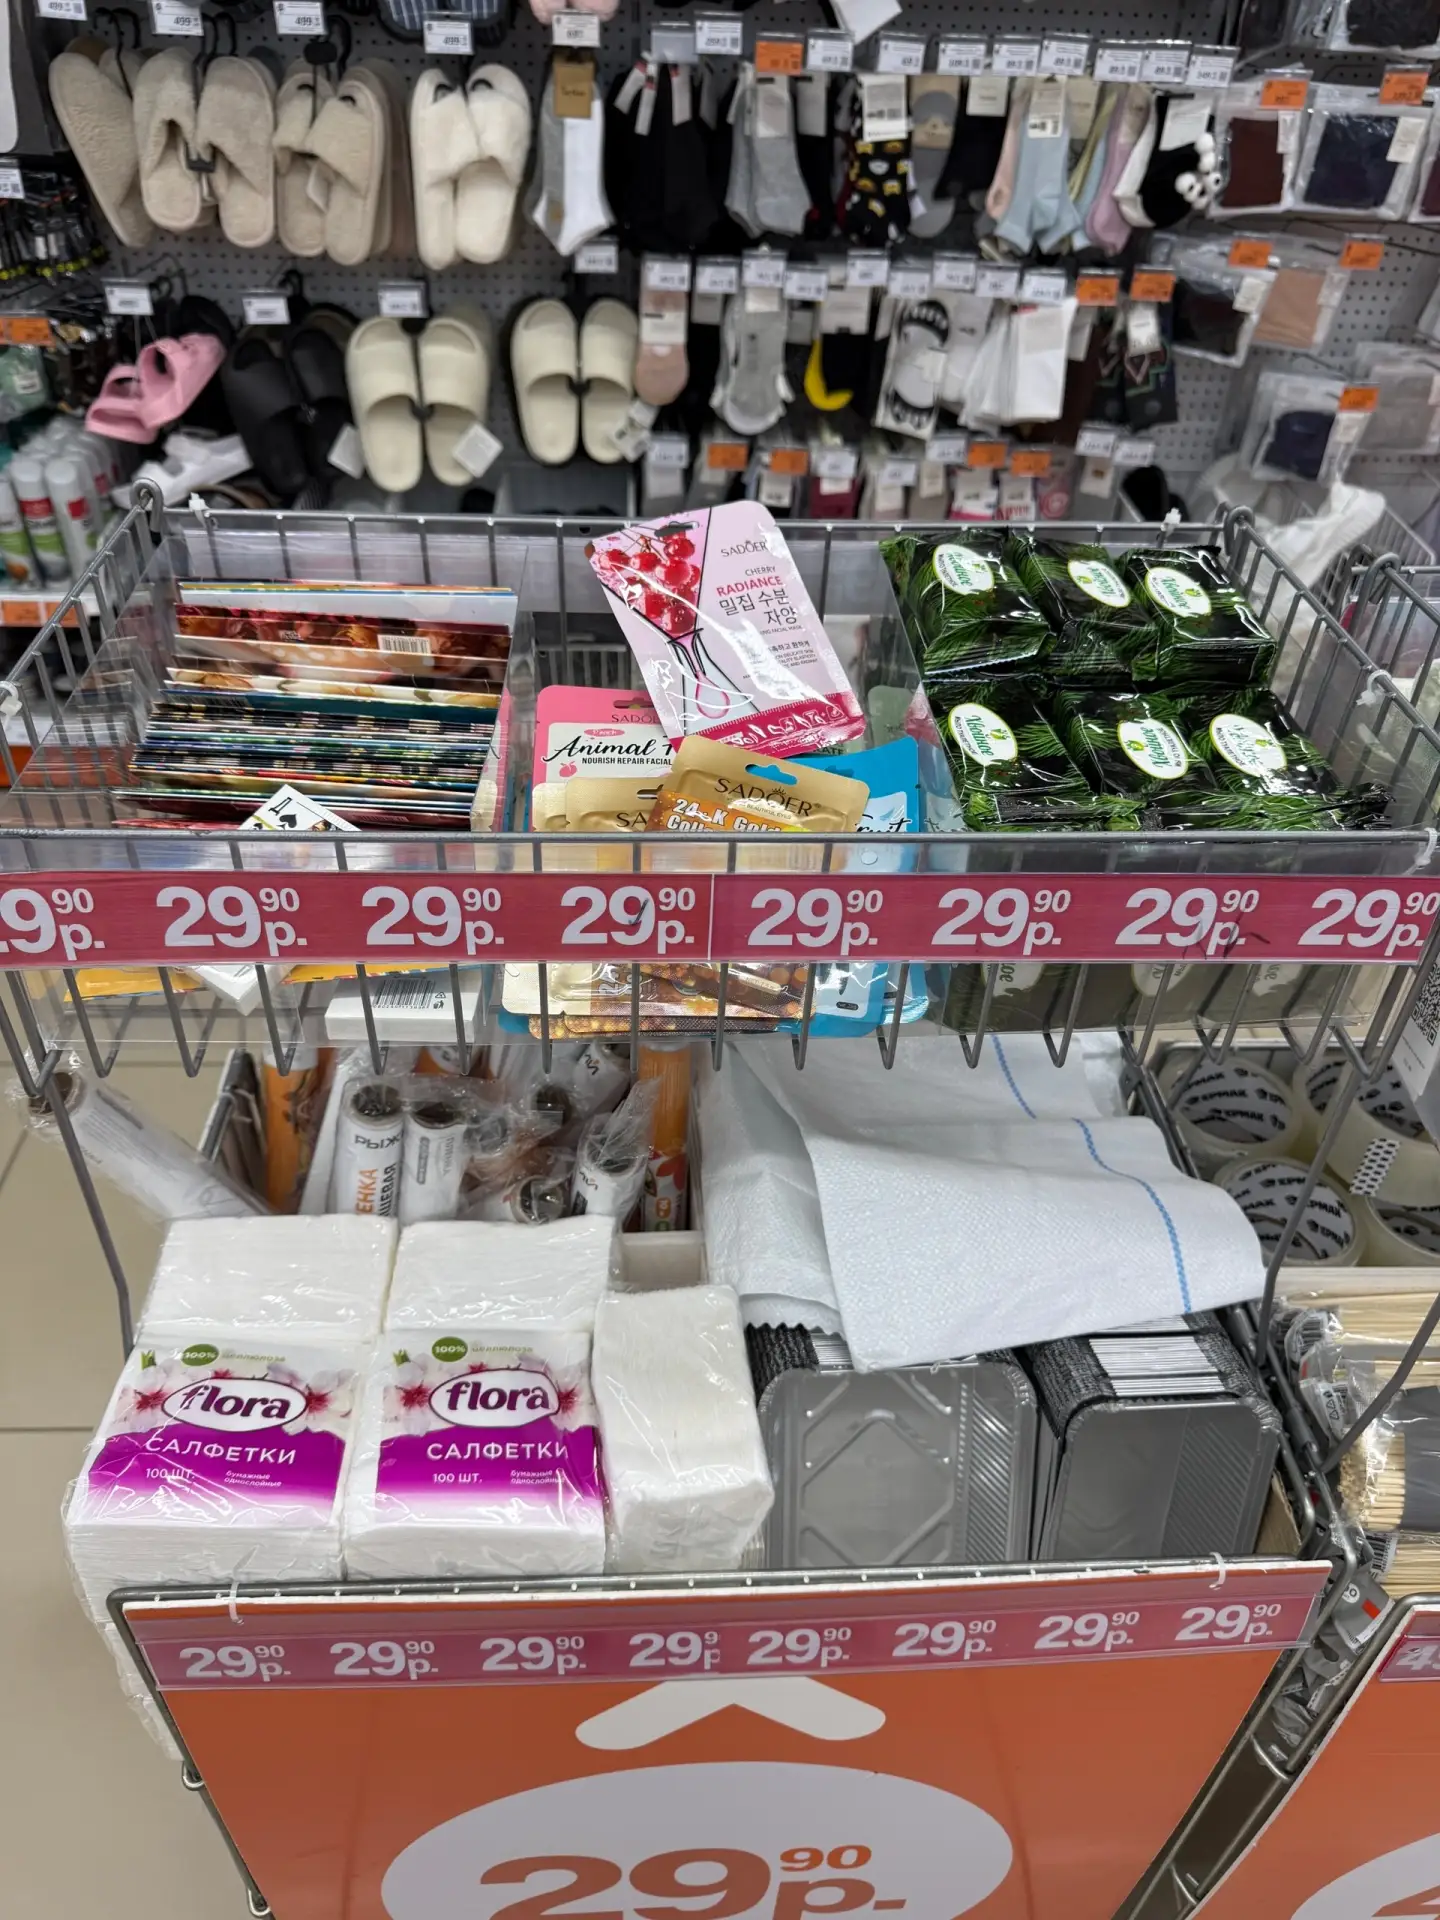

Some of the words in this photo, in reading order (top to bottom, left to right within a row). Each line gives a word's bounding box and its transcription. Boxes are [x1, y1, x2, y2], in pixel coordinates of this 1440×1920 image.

[720, 539, 767, 557] SADOER
[716, 575, 783, 597] RADIANCE
[745, 565, 776, 577] CHERRY
[719, 593, 756, 616] 밀집
[758, 588, 790, 608] 수분
[763, 606, 797, 626] 자양
[542, 735, 657, 763] Animal
[964, 715, 995, 755] Хвойное
[1141, 727, 1172, 768] Хвойное
[581, 757, 616, 765] NOURISH
[616, 757, 645, 765] REPAIR
[645, 758, 673, 766] FACIAL
[715, 778, 813, 818] SADOER
[0, 888, 57, 954] 9
[52, 888, 95, 914] 90
[156, 886, 262, 948] 29
[259, 887, 300, 913] 90
[362, 886, 463, 947] 29
[462, 888, 502, 912] 90
[560, 885, 656, 947] 29
[658, 887, 696, 912] 90
[747, 888, 844, 948] 29
[846, 889, 884, 914] 90
[931, 888, 1031, 948] 29
[1032, 889, 1072, 914] 90
[1114, 887, 1218, 947] 29
[1220, 889, 1260, 914] 90
[1297, 888, 1402, 948] 29
[1403, 891, 1440, 916] 90
[355, 1168, 378, 1215] ЕНКА
[183, 1351, 217, 1360] 100%
[435, 1345, 466, 1353] 100%
[181, 1384, 291, 1420] flora
[446, 1381, 550, 1411] flora
[145, 1437, 297, 1465] САЛФЕТКИ
[426, 1442, 569, 1460] САЛФЕТКИ
[145, 1468, 168, 1479] 100
[171, 1468, 195, 1480] ШТ.
[224, 1477, 282, 1487] однослойные
[225, 1470, 271, 1480] бумажные
[433, 1473, 455, 1483] 100
[458, 1473, 483, 1484] ШТ.
[892, 1621, 966, 1657] 29
[968, 1619, 997, 1634] 90
[1034, 1612, 1109, 1649] 29
[1111, 1611, 1140, 1626] 90
[1175, 1604, 1250, 1641] 29
[1252, 1603, 1282, 1618] 90
[179, 1645, 257, 1679] 29
[254, 1644, 285, 1659] 90
[329, 1641, 406, 1676] 29
[405, 1640, 435, 1655] 90
[479, 1636, 556, 1672] 29
[555, 1636, 586, 1650] 90
[628, 1631, 703, 1668] 29
[746, 1628, 821, 1666] 29
[823, 1626, 852, 1642] 90
[480, 1848, 771, 1920] 29
[779, 1844, 872, 1872] 90
